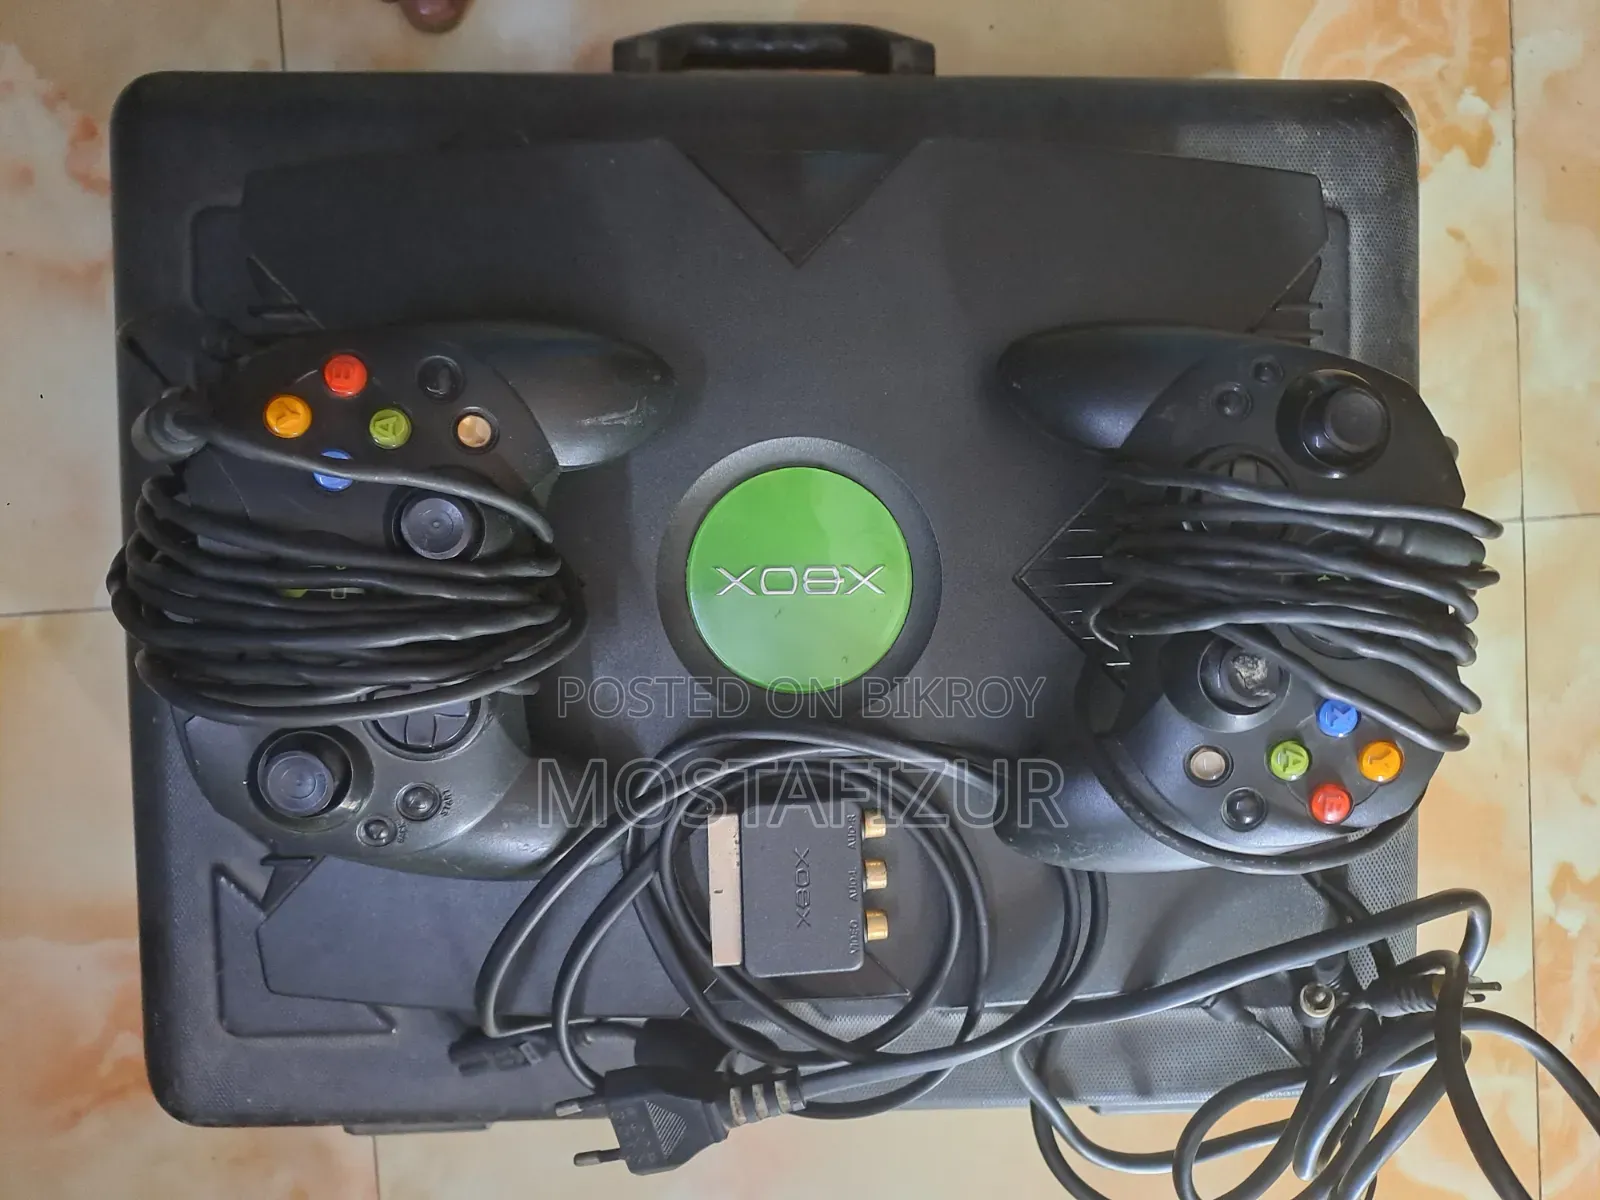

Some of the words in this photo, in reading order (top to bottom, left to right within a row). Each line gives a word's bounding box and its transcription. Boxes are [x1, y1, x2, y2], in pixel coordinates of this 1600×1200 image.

[374, 416, 401, 438] A
[713, 564, 886, 596] XBOX
[1282, 747, 1306, 773] A
[794, 847, 812, 929] XBOX
[849, 919, 861, 955] VIDEO
